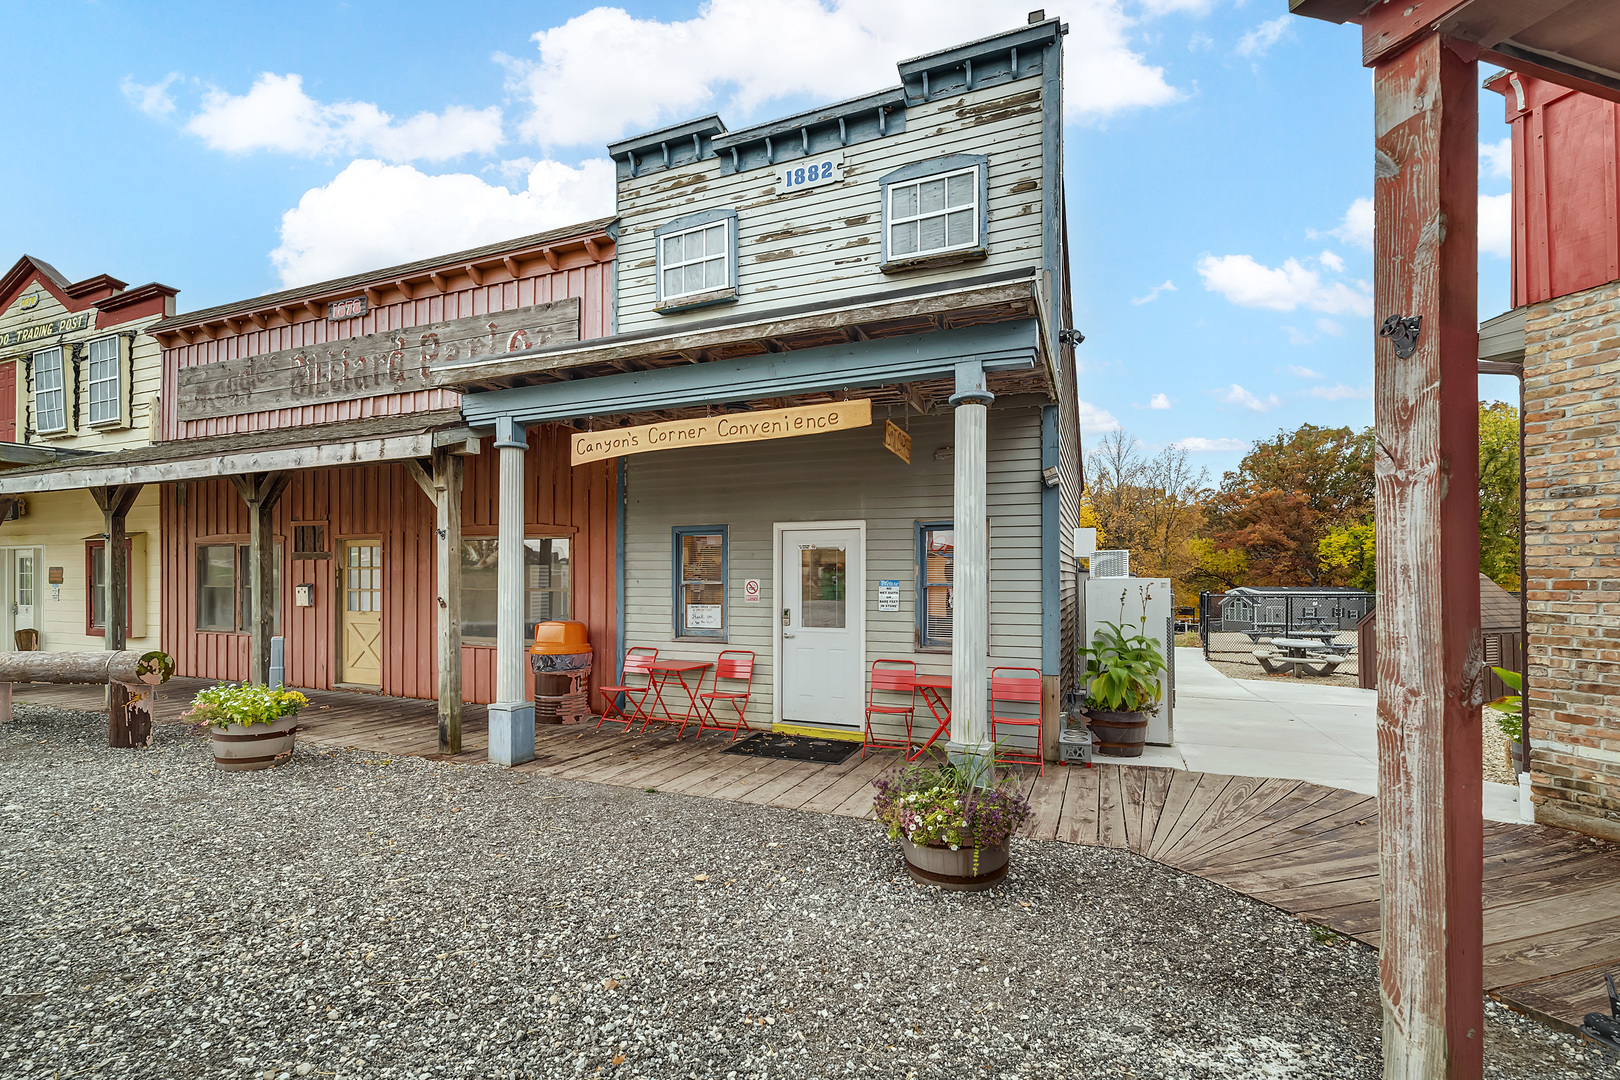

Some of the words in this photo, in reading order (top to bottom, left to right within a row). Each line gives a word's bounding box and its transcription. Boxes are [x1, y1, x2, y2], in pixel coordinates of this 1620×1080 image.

[786, 162, 832, 187] 1882
[16, 323, 54, 342] TRADING
[58, 315, 84, 332] POST
[576, 431, 639, 456] Canyon's
[648, 426, 708, 445] Corner
[717, 412, 840, 438] Convenience
